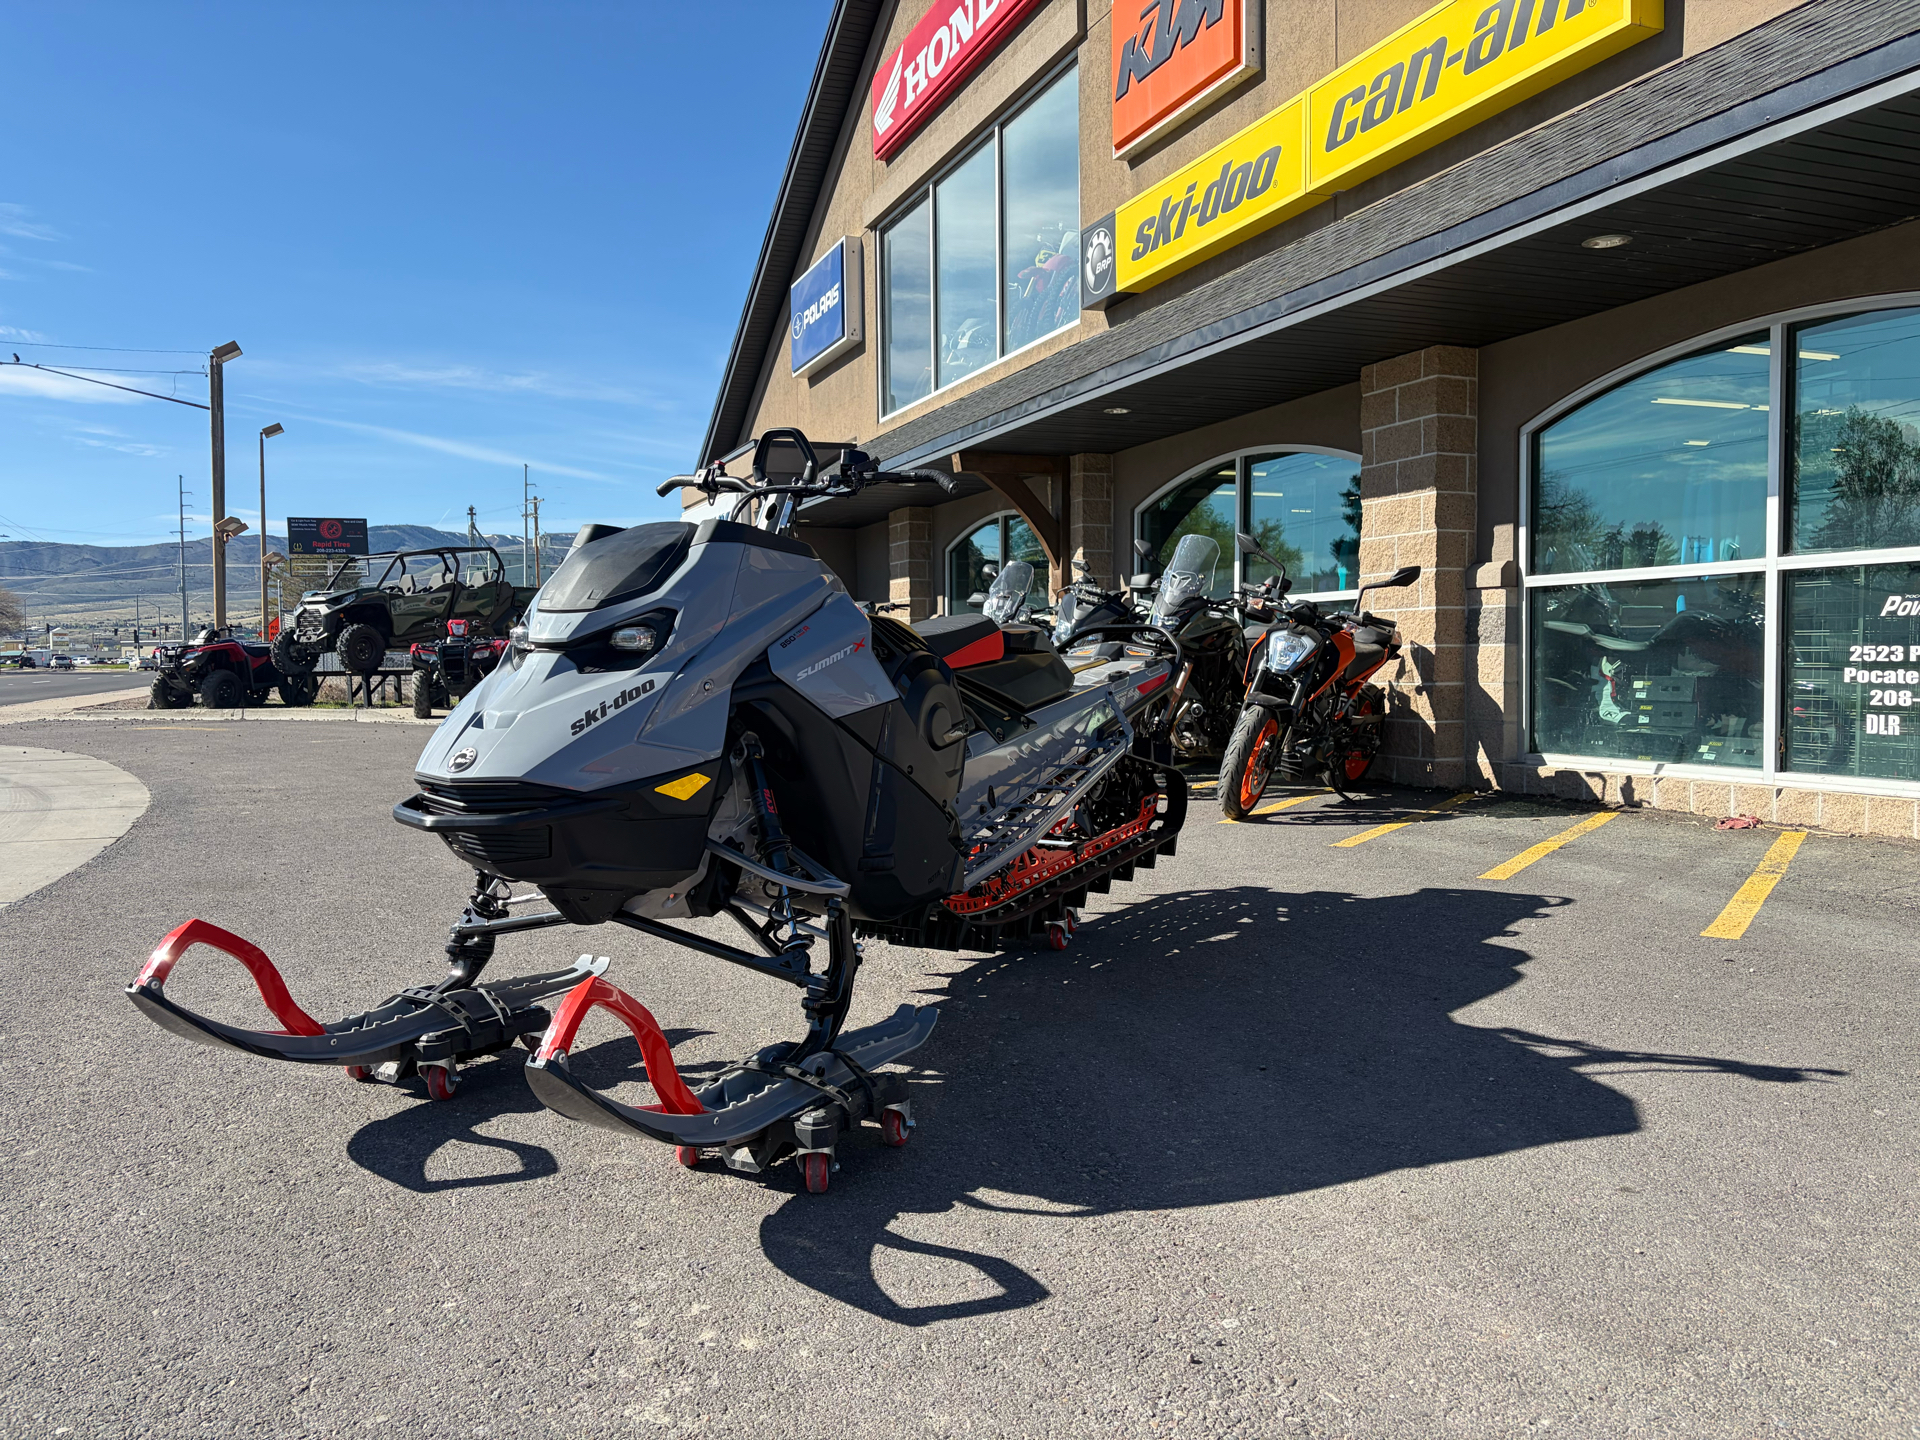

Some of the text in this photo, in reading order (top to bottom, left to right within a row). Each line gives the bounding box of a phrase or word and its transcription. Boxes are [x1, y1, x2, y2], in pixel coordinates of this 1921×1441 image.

[1115, 0, 1224, 104] KTM
[1131, 145, 1282, 262] ski-doo
[1095, 256, 1112, 275] BRP
[803, 281, 840, 330] POLARIS
[780, 635, 796, 649] 850
[1849, 645, 1904, 662] 2523
[1844, 667, 1920, 684] Pocate
[570, 679, 655, 736] ski-doo
[1869, 690, 1920, 707] 208-
[1866, 714, 1900, 736] DLR
